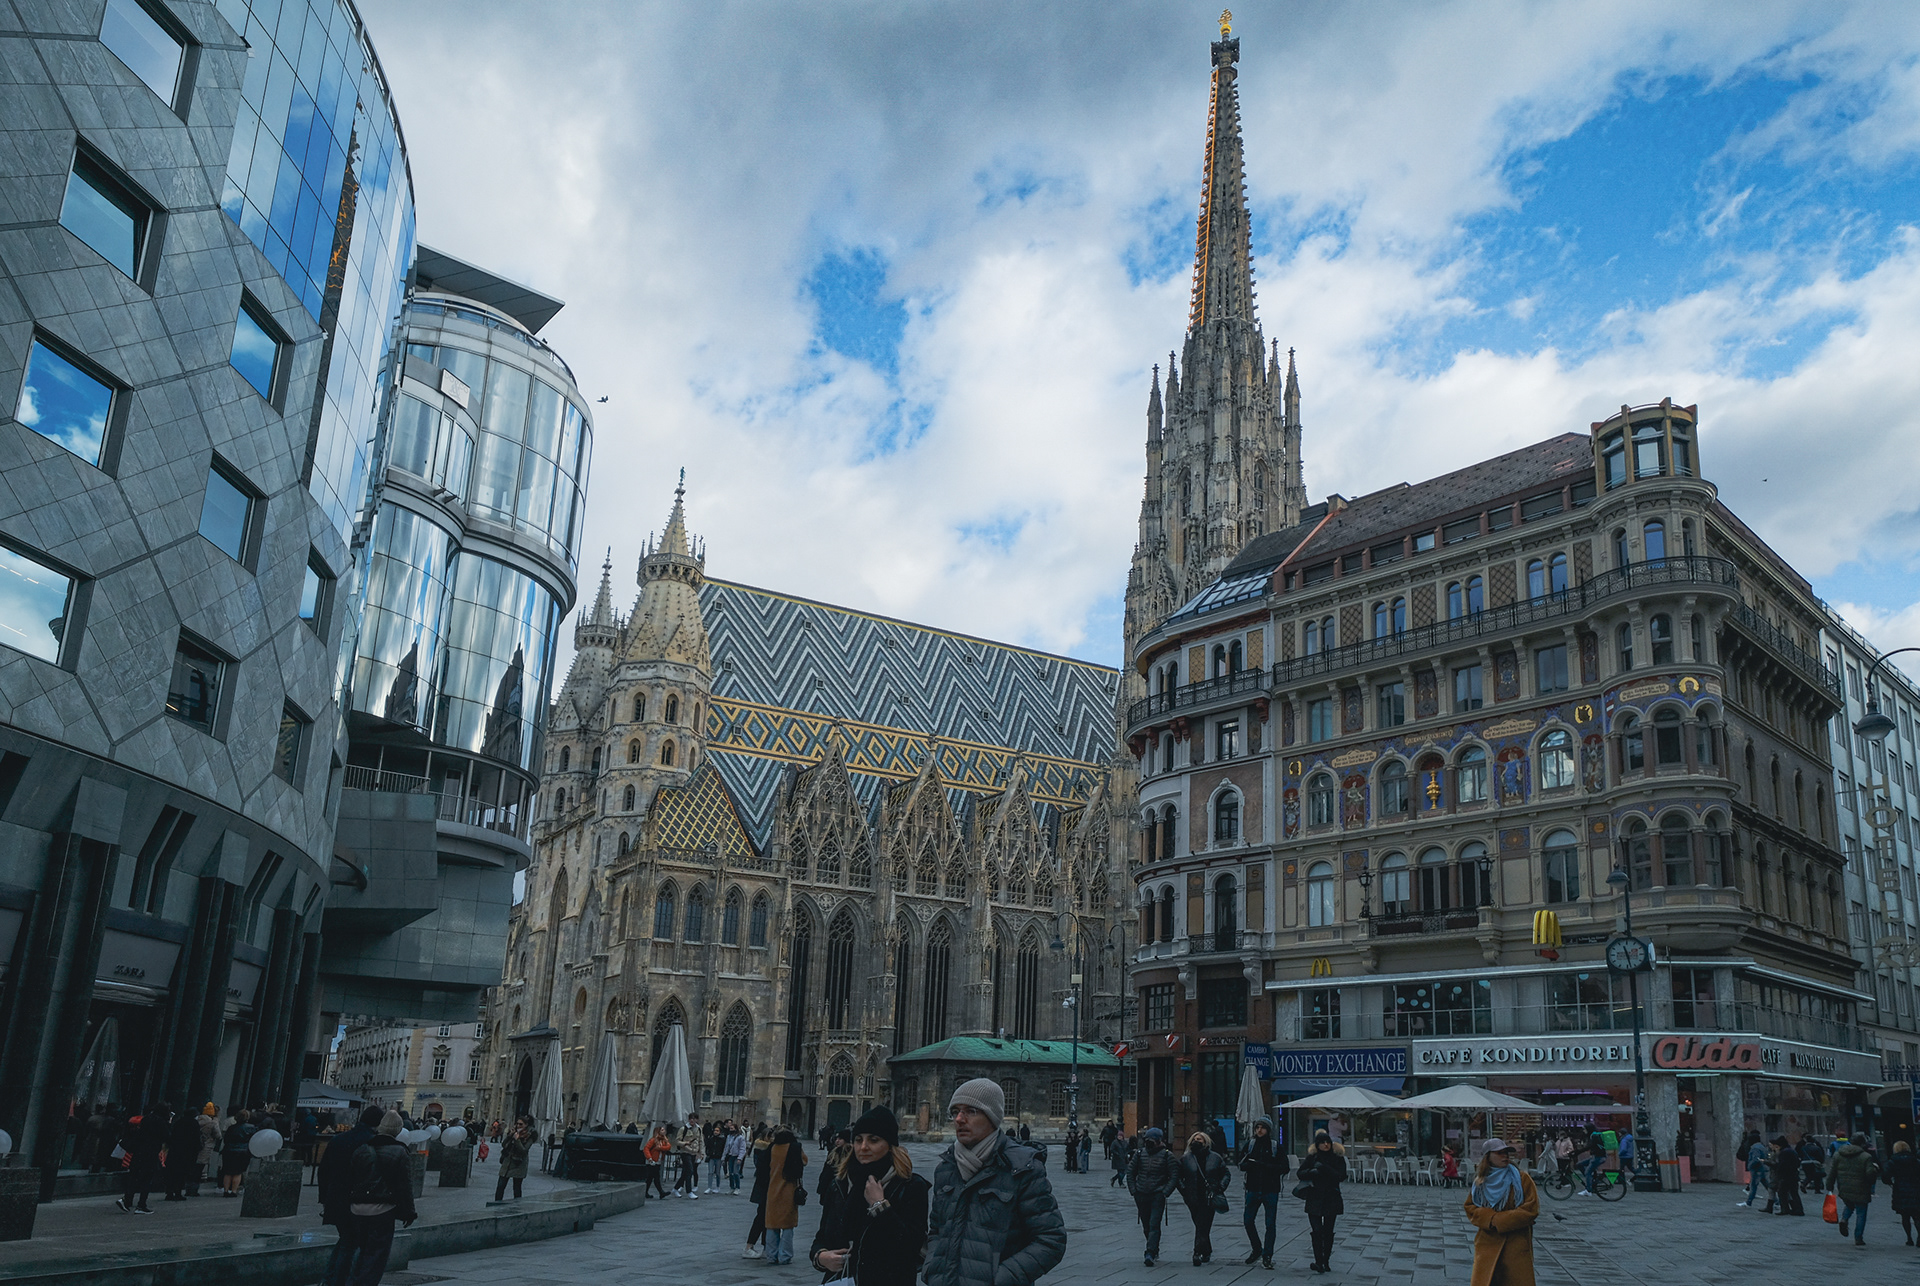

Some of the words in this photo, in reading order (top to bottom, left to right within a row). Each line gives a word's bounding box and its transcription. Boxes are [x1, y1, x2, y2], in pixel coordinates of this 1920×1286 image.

[1865, 774, 1902, 924] HOTEL
[113, 964, 146, 979] ZARA
[1247, 1045, 1268, 1055] CAMBIO
[1479, 1045, 1630, 1064] KONDITOREI
[1244, 1056, 1270, 1067] CHANGE
[1273, 1054, 1323, 1074] MONEY
[1326, 1052, 1407, 1073] EXCHANGE
[1794, 1053, 1837, 1072] KONDITOREI
